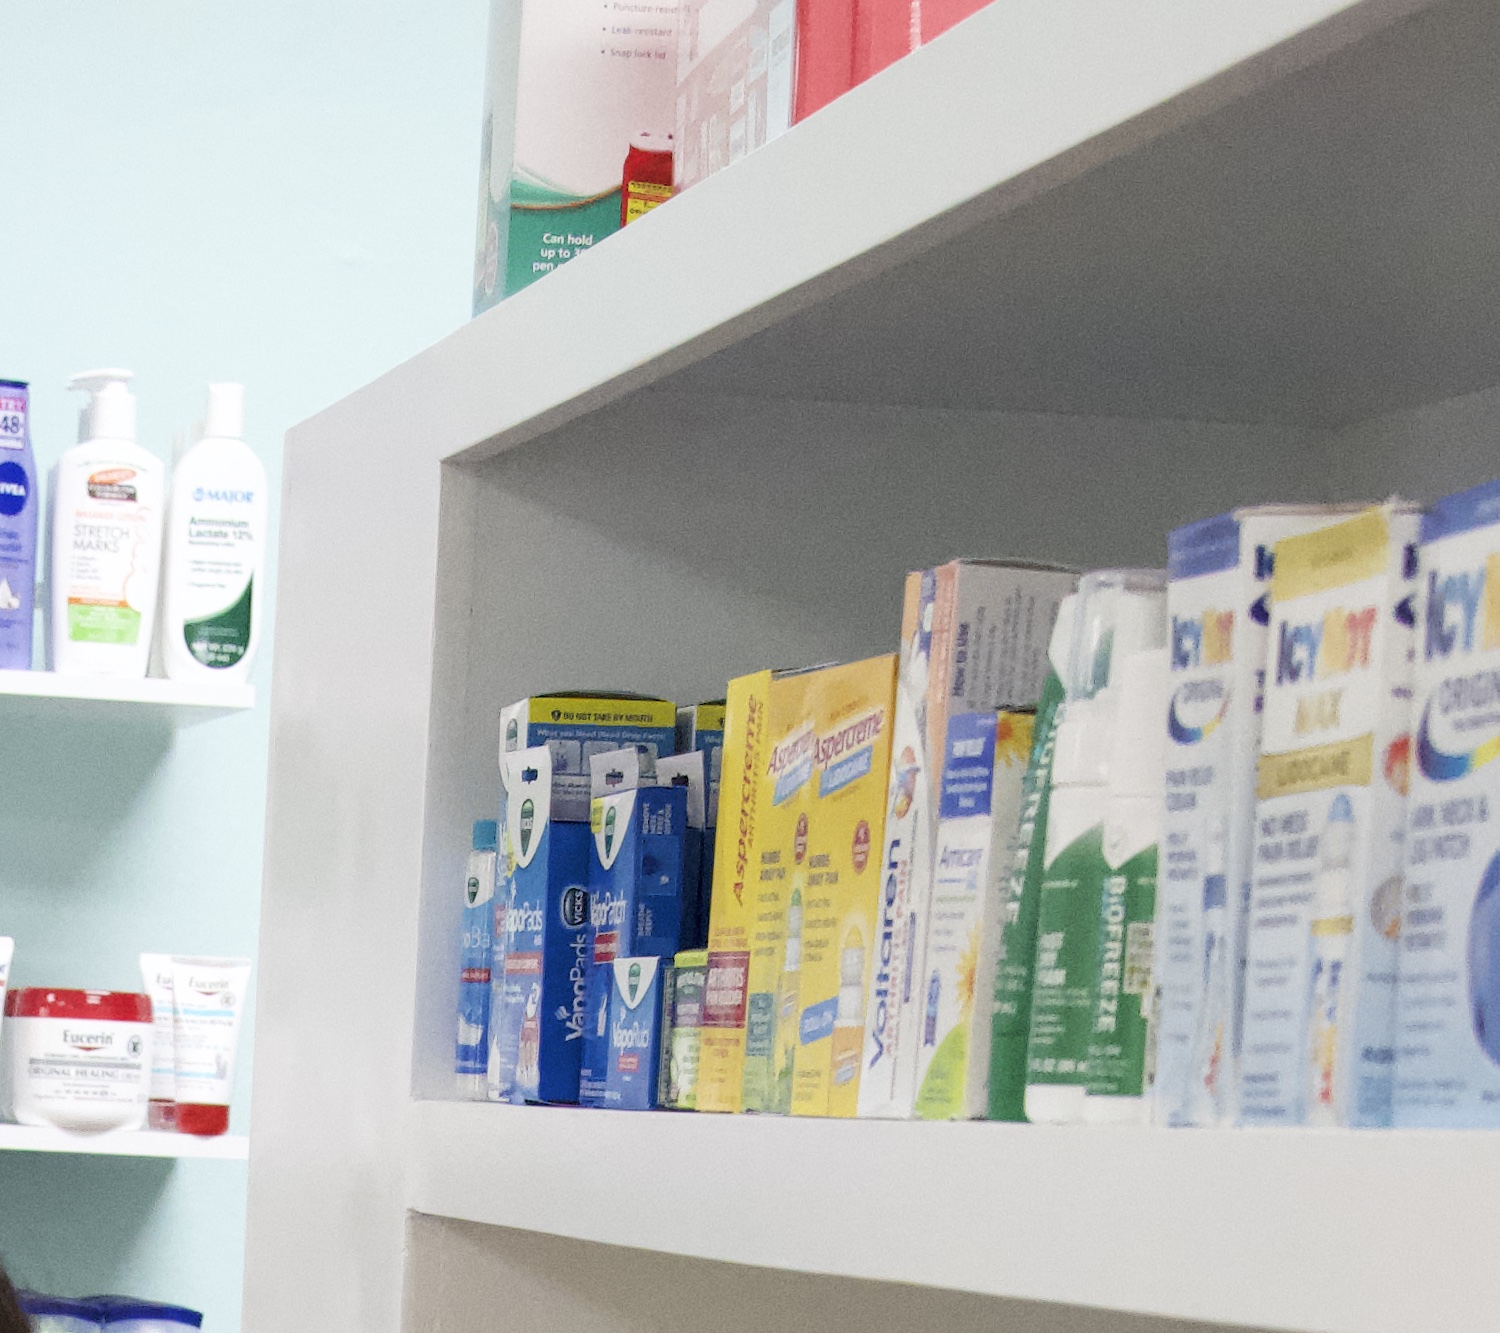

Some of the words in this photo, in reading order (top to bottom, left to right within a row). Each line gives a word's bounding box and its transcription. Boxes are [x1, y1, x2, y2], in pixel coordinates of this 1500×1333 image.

[543, 233, 564, 245] Can
[567, 233, 593, 246] hold
[540, 247, 556, 260] up
[205, 488, 254, 503] MAJOR
[188, 516, 250, 532] Ammonium
[73, 524, 131, 543] STRETCH
[73, 538, 121, 555] MARKS
[734, 695, 757, 907] Aspercreme
[574, 890, 584, 924] VICKS
[869, 838, 900, 1071] Voltaren
[1097, 877, 1129, 1034] BIOFREEZE
[565, 934, 586, 1042] VapoPads
[62, 1029, 113, 1045] Eucerin
